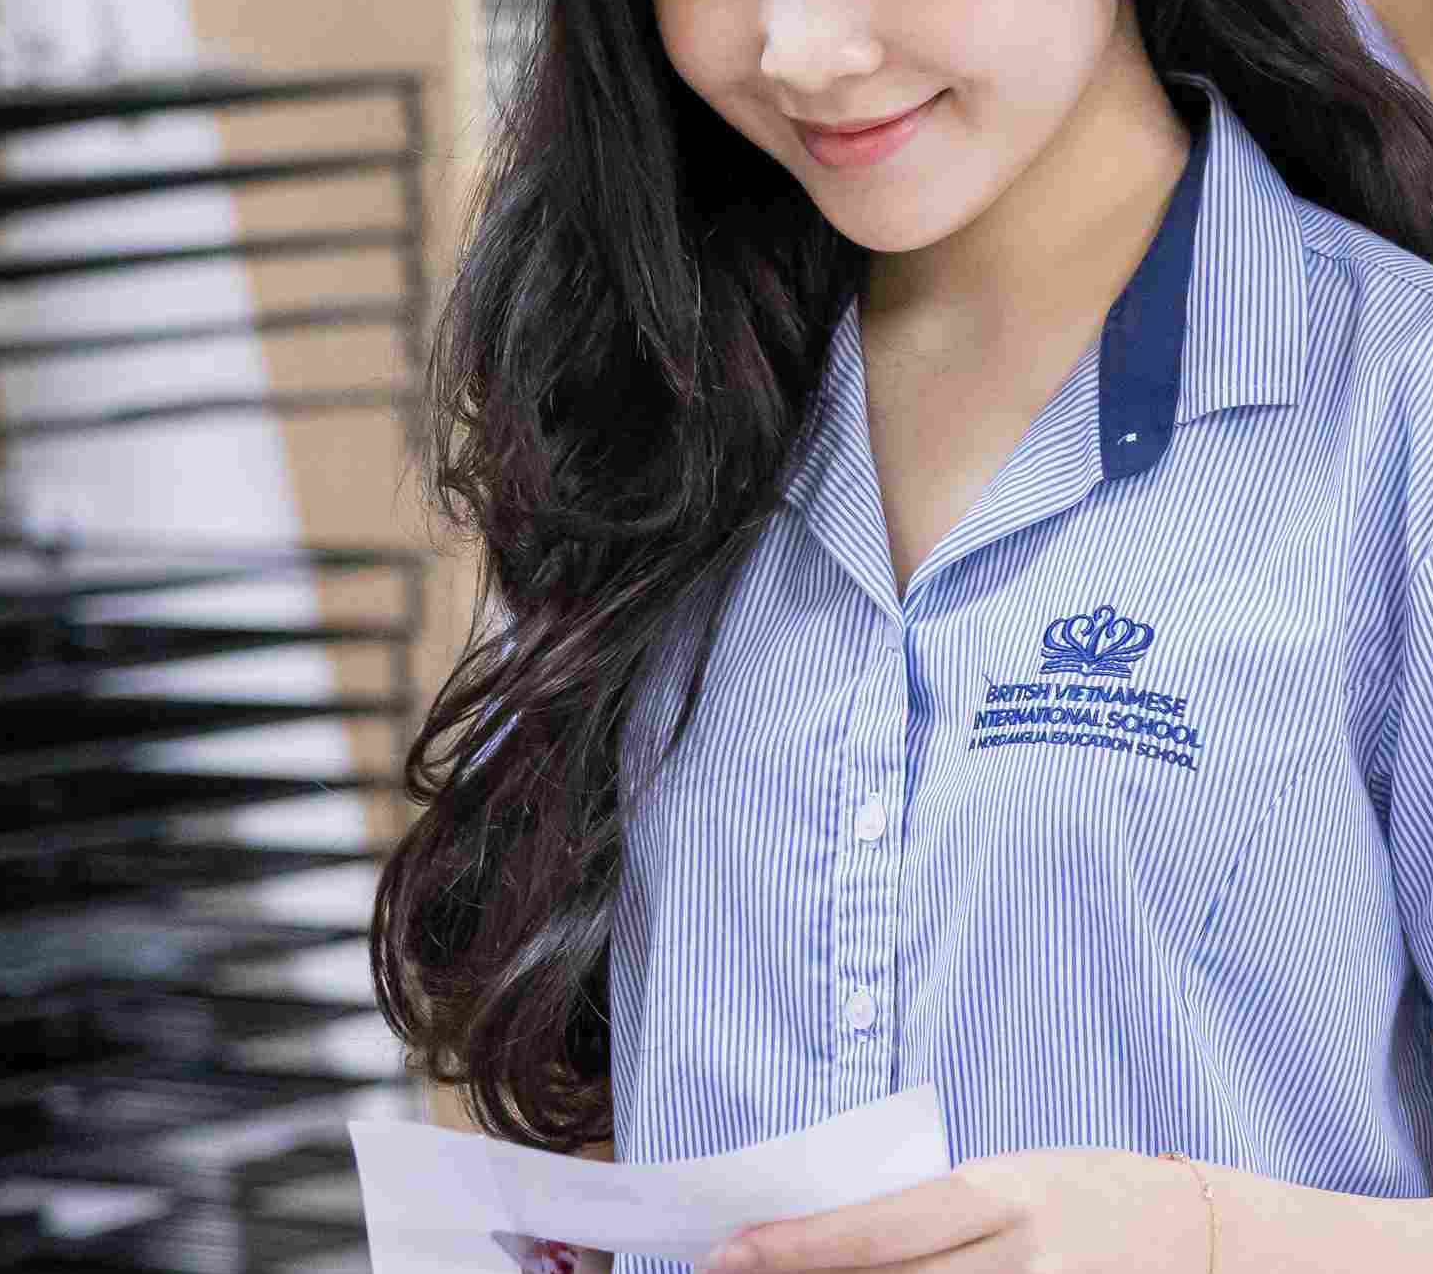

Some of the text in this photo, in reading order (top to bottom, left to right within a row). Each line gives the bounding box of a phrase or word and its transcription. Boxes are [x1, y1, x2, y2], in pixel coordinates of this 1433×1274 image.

[985, 684, 1188, 718] BRITISH VIETNAMESE
[1105, 711, 1204, 748] SCHOOL
[1051, 732, 1132, 753] EDUCATION
[1136, 741, 1198, 770] SCHOOL
